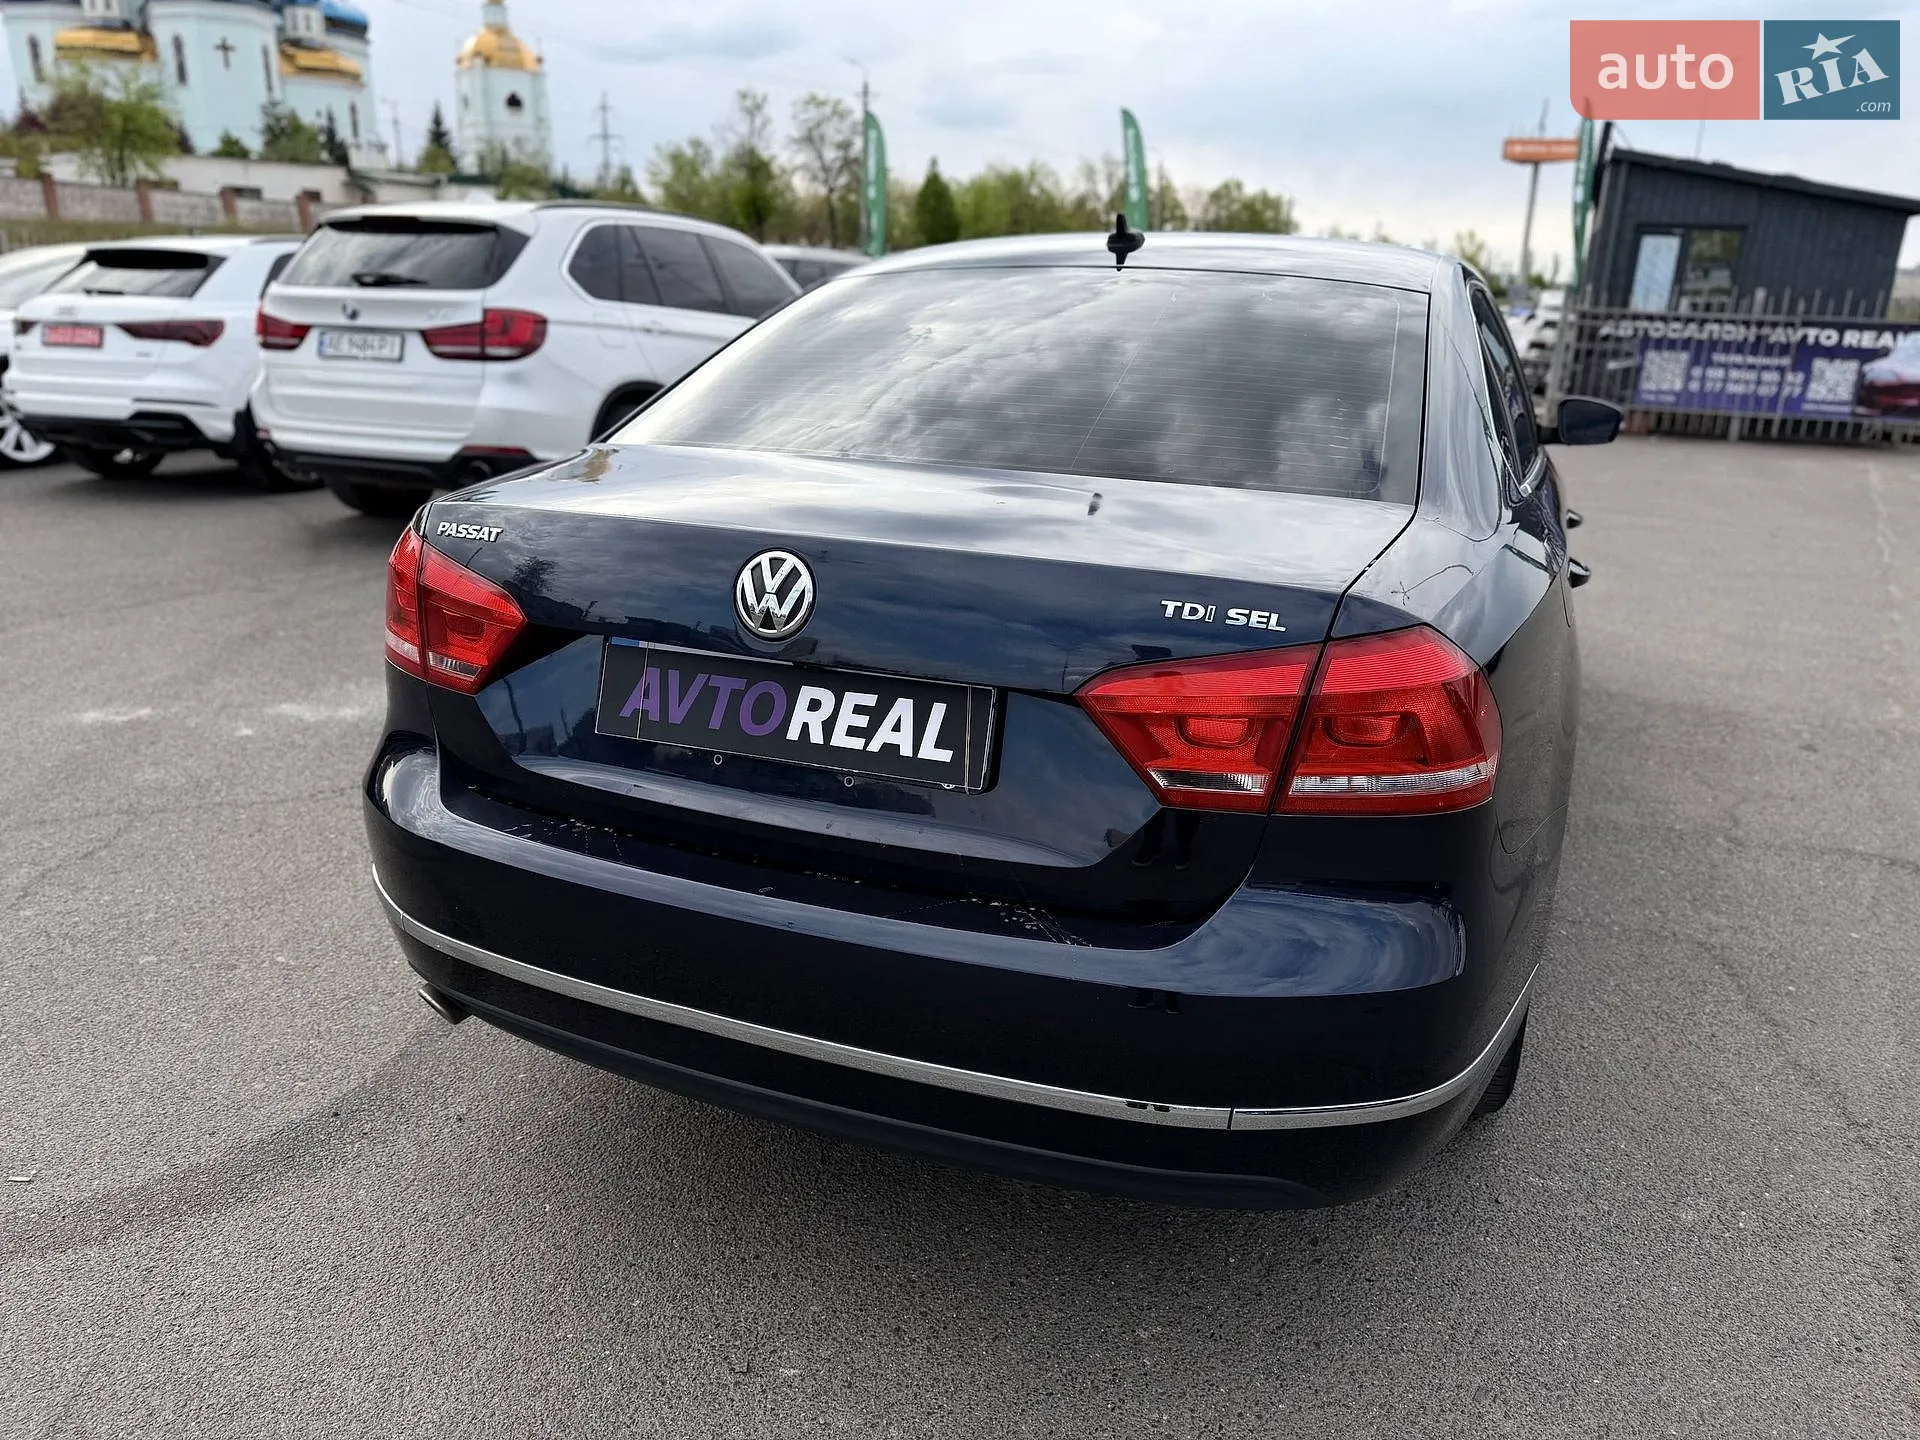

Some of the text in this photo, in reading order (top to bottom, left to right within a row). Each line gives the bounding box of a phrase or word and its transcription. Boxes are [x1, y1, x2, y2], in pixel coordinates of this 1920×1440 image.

[437, 522, 503, 542] PASSAT
[1161, 600, 1287, 632] TDI SEL
